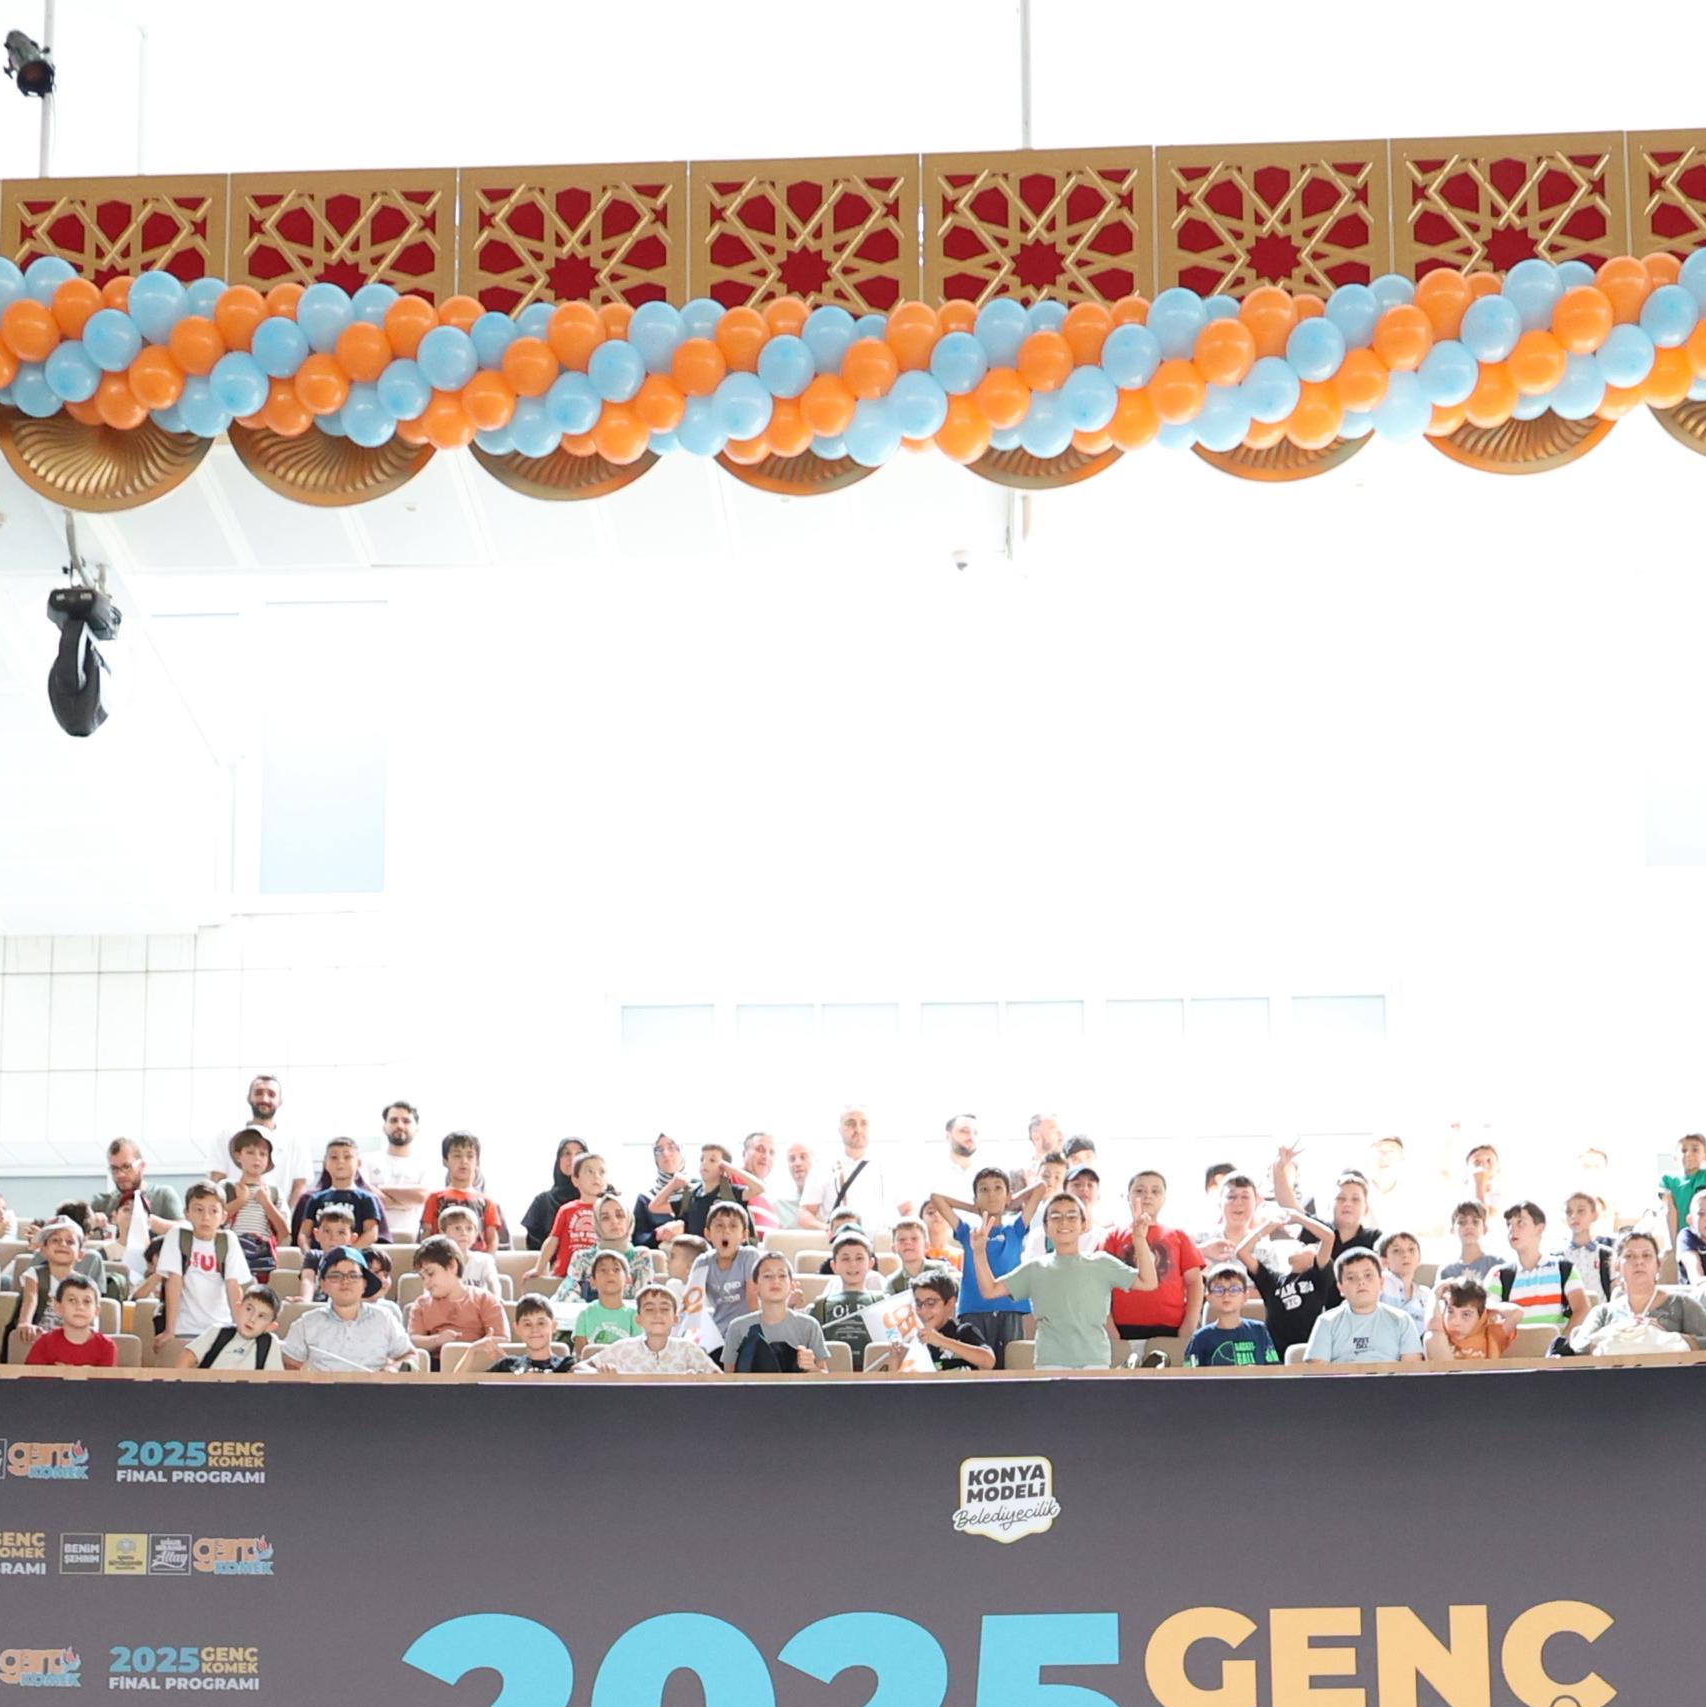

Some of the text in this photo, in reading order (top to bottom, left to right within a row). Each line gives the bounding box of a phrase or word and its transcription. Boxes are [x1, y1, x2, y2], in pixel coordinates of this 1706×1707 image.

[117, 1440, 207, 1467] 2025
[209, 1456, 265, 1468] KOMEK
[172, 1471, 265, 1483] PROGRAMI
[968, 1464, 1046, 1486] KONYA
[966, 1482, 1046, 1504] MODELİ
[955, 1500, 1059, 1531] Belediyecilik
[110, 1645, 200, 1673] 2025
[203, 1662, 257, 1673] KOMEK
[166, 1678, 259, 1690] PROGRAMI
